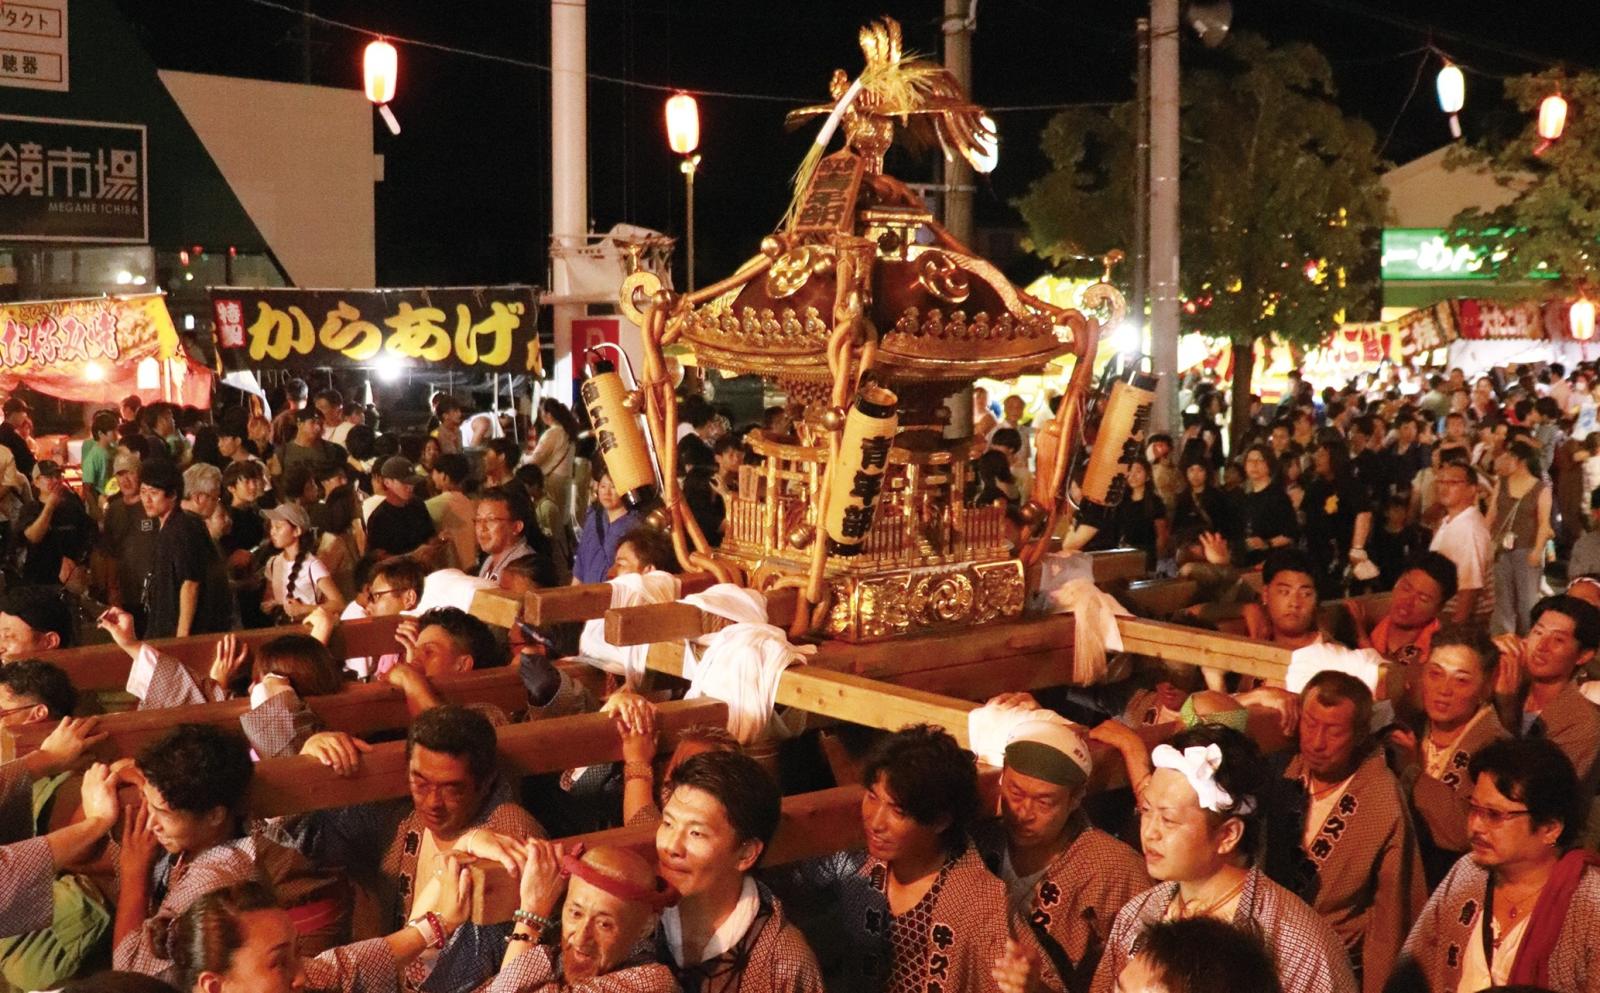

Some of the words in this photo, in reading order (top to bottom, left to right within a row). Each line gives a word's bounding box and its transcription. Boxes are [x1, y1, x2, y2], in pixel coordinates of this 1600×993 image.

[0, 8, 49, 31] タクト
[2, 54, 38, 75] 聴器
[0, 141, 138, 200] 鏡市場
[48, 202, 97, 214] MEGANE
[101, 204, 139, 215] ICHIBA
[248, 300, 525, 366] からあげ
[1310, 793, 1359, 861] 牛久市
